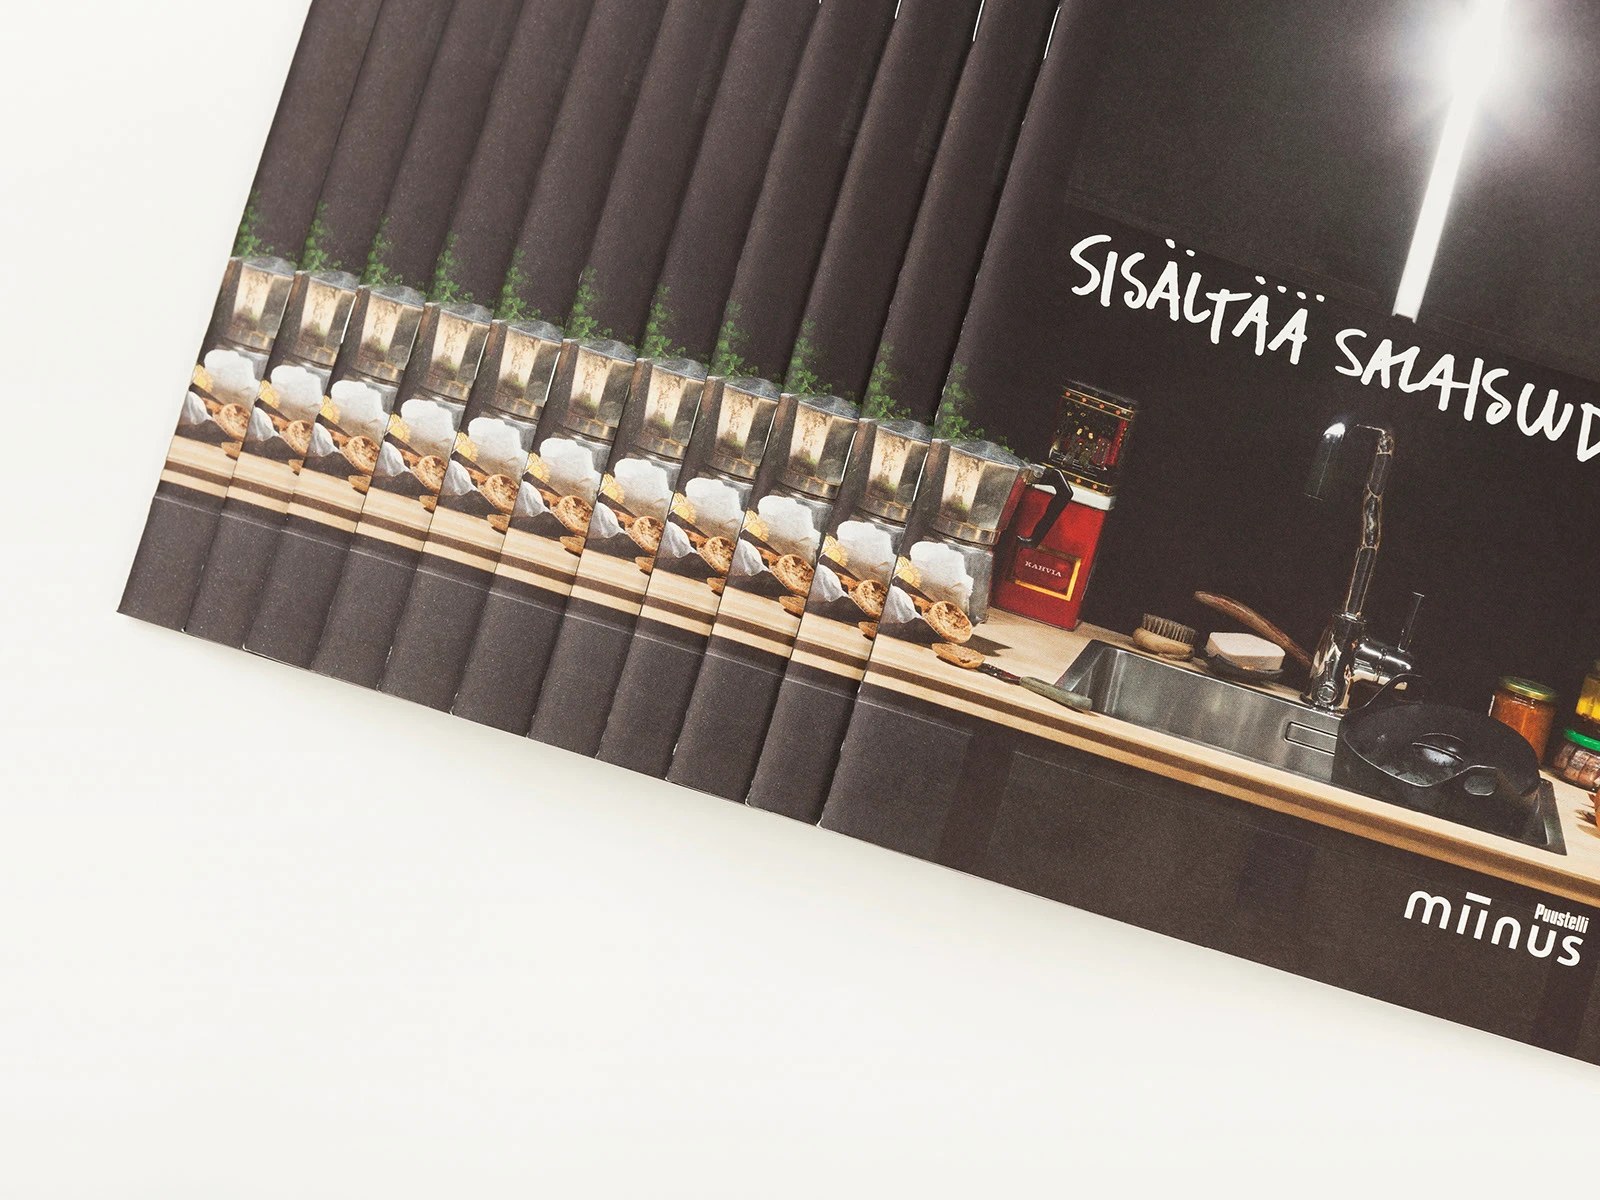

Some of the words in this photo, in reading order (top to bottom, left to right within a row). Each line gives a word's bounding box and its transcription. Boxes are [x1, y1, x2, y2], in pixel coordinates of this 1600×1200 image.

[1069, 234, 1325, 365] SISÄLTÄÄ
[1024, 560, 1062, 578] KAHVIA
[1533, 903, 1590, 934] Puustelli
